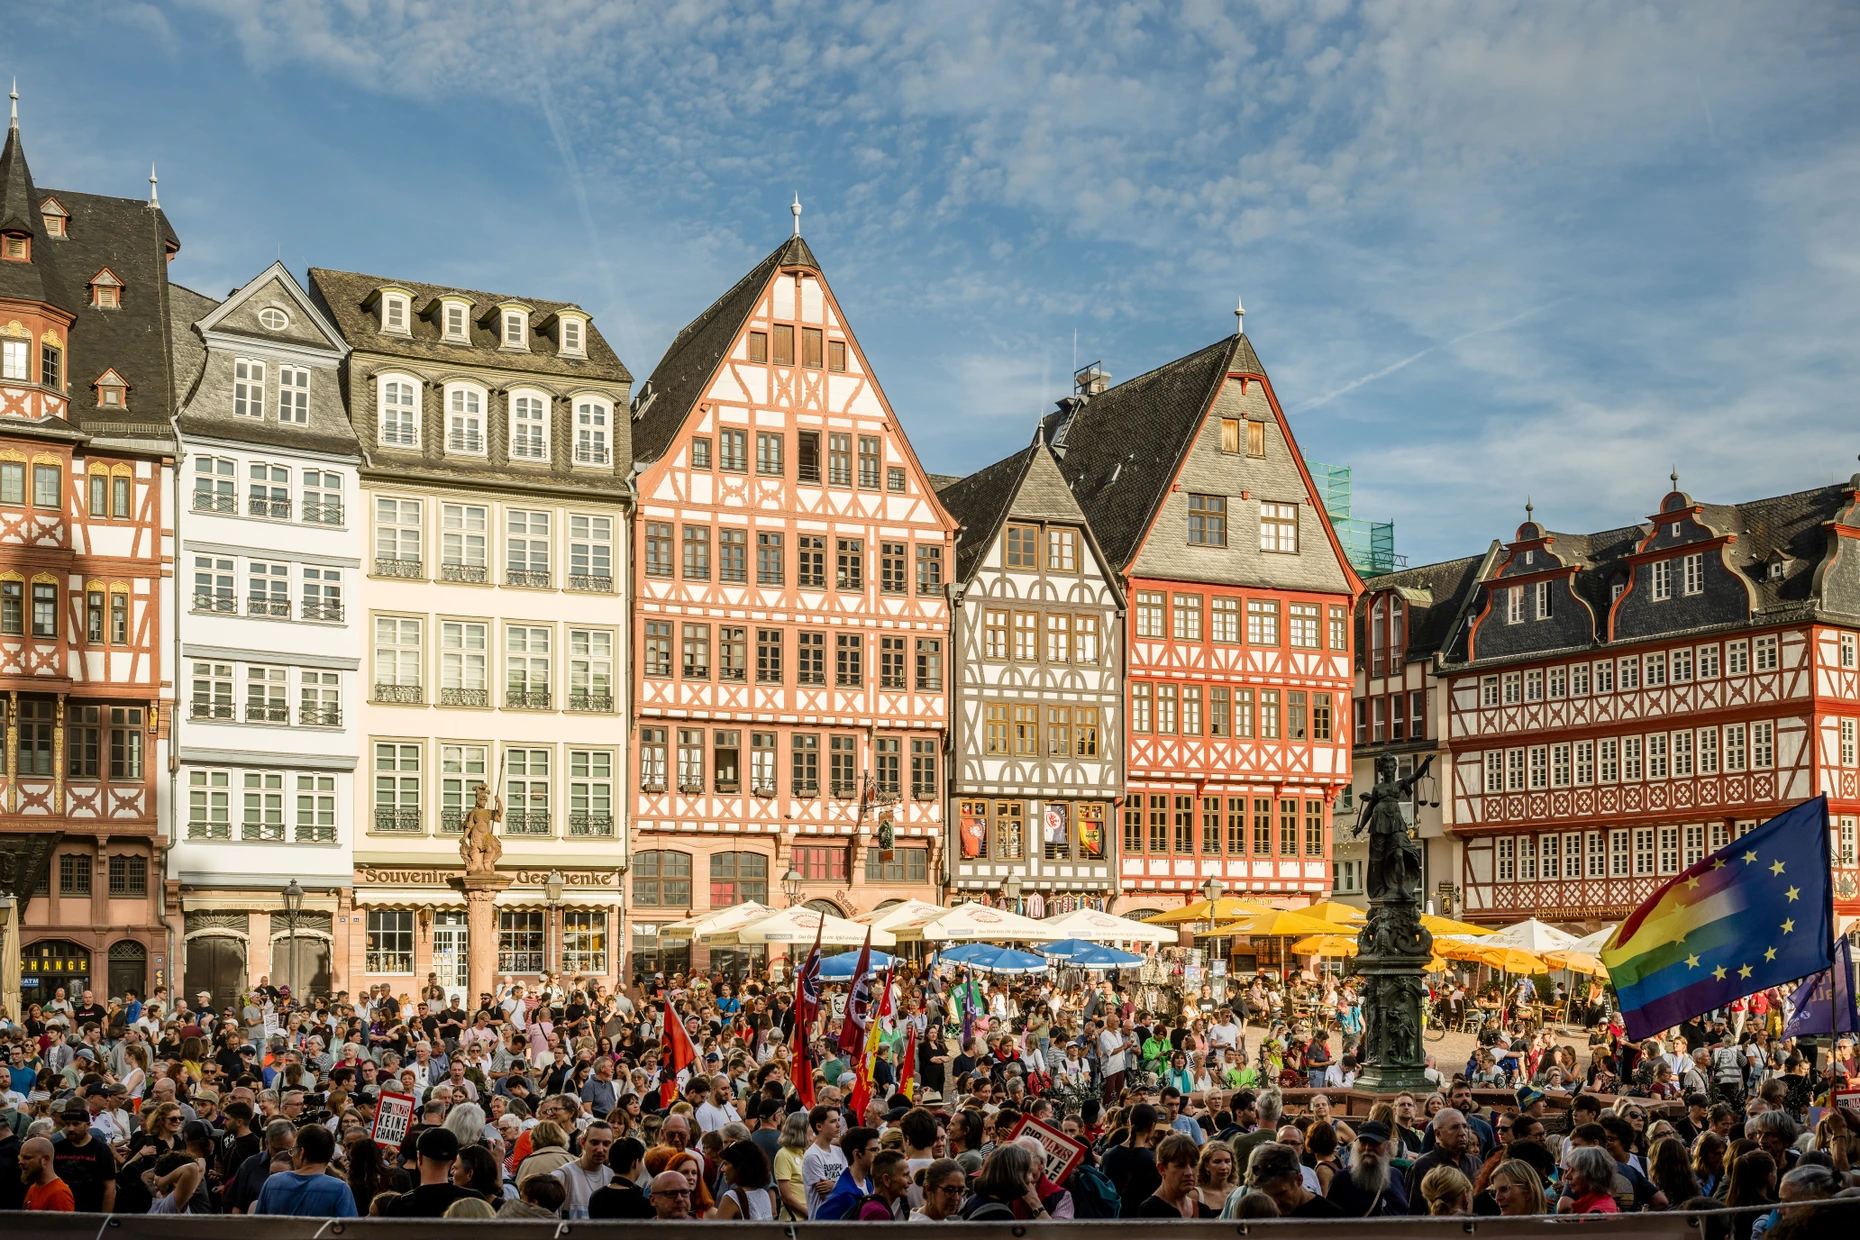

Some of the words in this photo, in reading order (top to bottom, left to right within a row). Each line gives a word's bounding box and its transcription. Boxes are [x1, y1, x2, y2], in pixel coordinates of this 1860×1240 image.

[516, 870, 613, 885] Geshenke
[1534, 907, 1603, 918] RESTAURANT
[20, 960, 87, 971] CHANGE
[381, 1101, 392, 1114] GIB
[391, 1103, 410, 1117] NAZIS
[378, 1114, 407, 1130] KEINE
[376, 1127, 404, 1142] CHANCE
[1040, 1135, 1073, 1161] NAZIS
